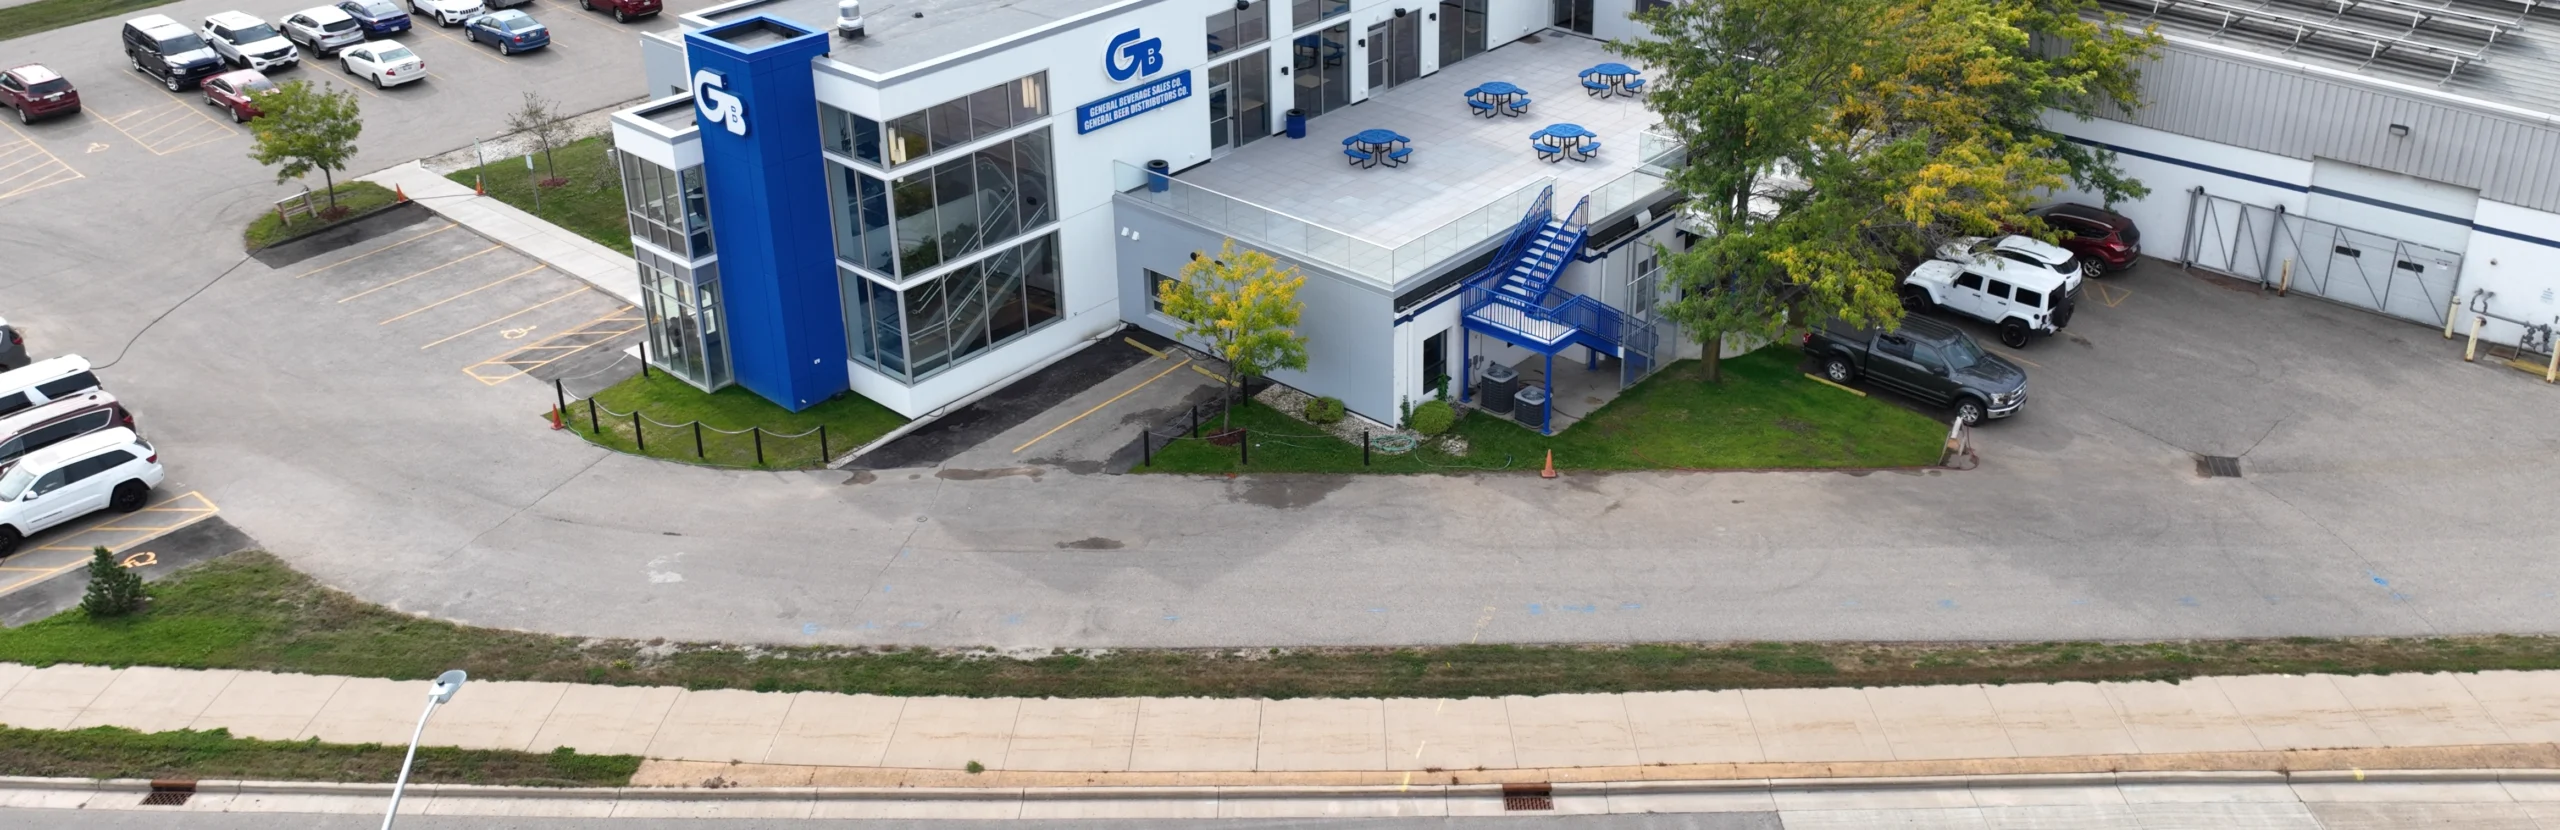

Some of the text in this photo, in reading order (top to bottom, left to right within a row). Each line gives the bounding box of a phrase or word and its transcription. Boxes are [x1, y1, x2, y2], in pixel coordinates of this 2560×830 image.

[1105, 27, 1164, 82] GB
[693, 69, 747, 136] GB
[1084, 86, 1189, 131] GENERAL BEER DISTRIBUTORS CO.
[1089, 77, 1183, 117] GENERAL BEVERAGE SALES CO.
